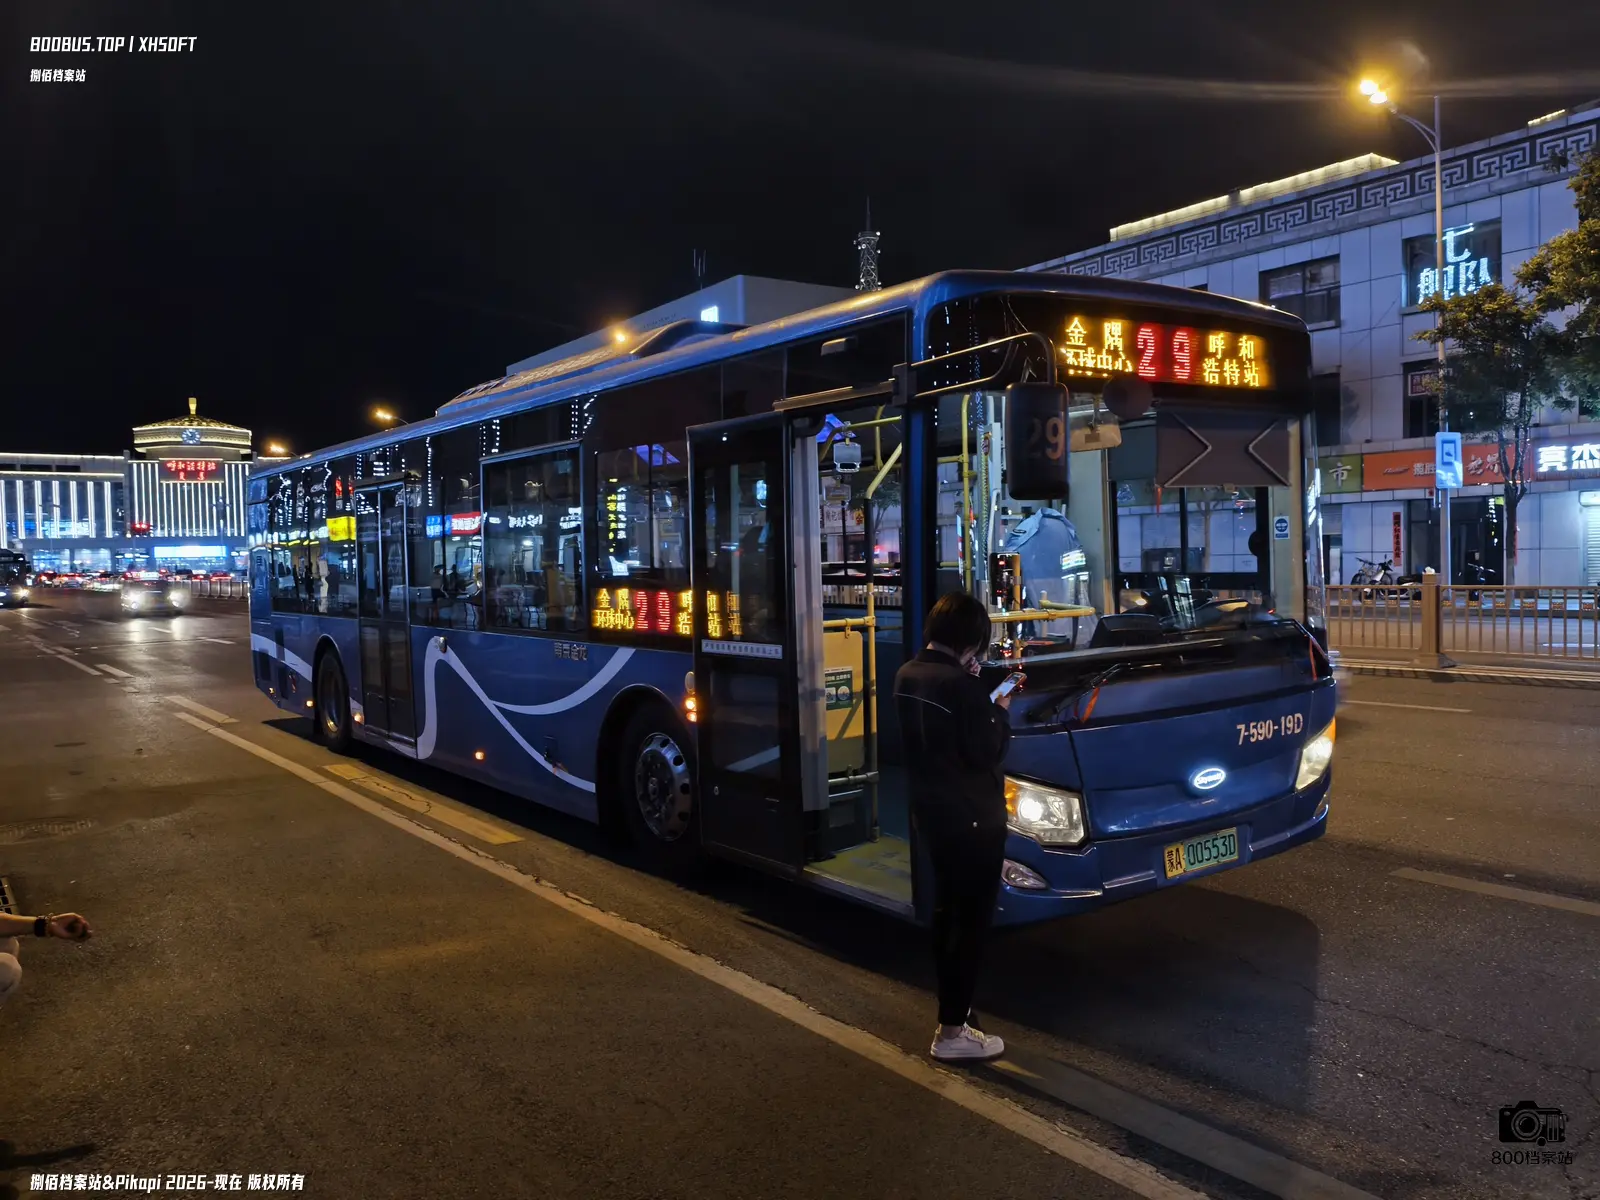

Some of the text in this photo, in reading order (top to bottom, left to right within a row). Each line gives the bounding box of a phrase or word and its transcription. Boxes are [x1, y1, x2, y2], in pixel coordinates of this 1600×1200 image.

[1137, 327, 1191, 379] 29
[1208, 333, 1256, 361] 呼和
[1203, 358, 1260, 387] 浩特站
[1329, 462, 1352, 489] 市
[635, 591, 670, 630] 29
[1236, 713, 1303, 745] 7-590-19D
